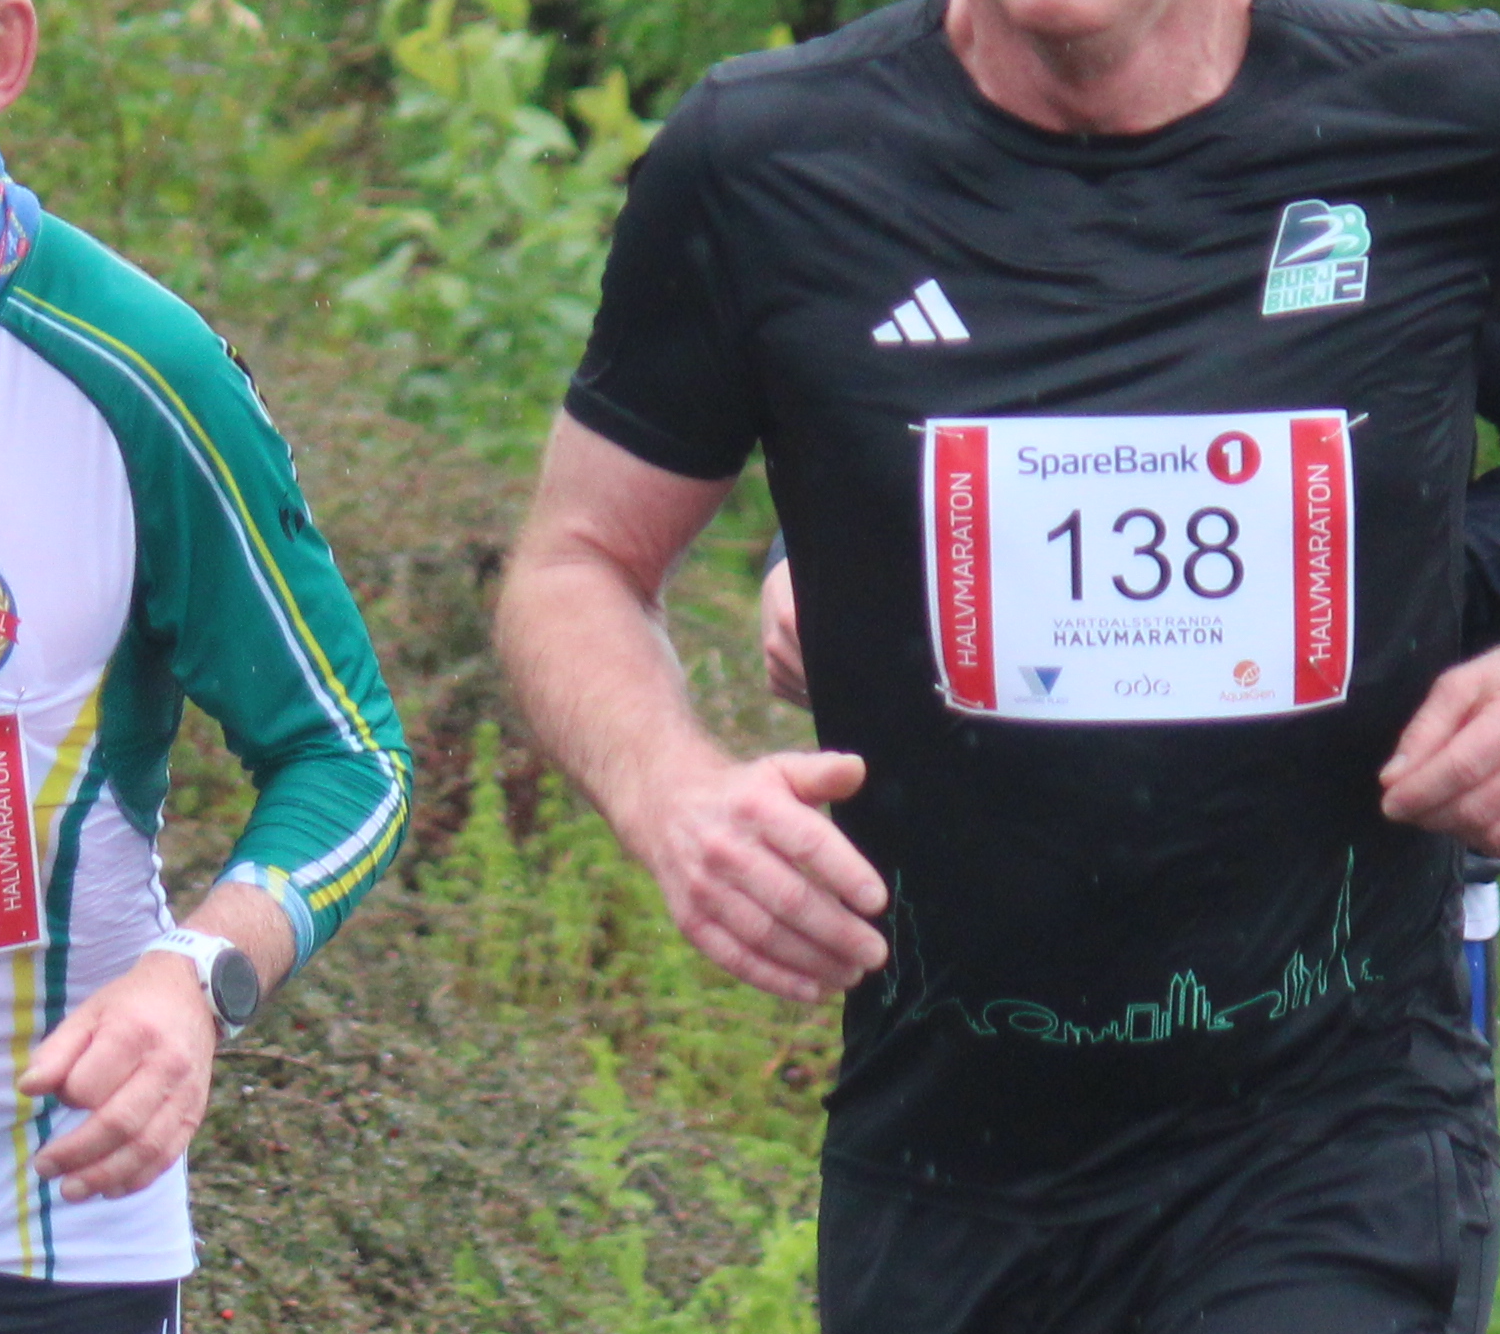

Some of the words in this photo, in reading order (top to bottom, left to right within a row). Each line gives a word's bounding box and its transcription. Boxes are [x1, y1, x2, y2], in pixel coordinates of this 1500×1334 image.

[1017, 445, 1199, 480] SpareBank
[1221, 439, 1245, 476] 1
[950, 472, 977, 666] HALVMARATON
[1047, 506, 1244, 601] 138
[1308, 463, 1331, 659] HALVMARATON
[1053, 615, 1223, 629] VARTDALSSTRANDA
[1054, 628, 1223, 647] HALVMARATON
